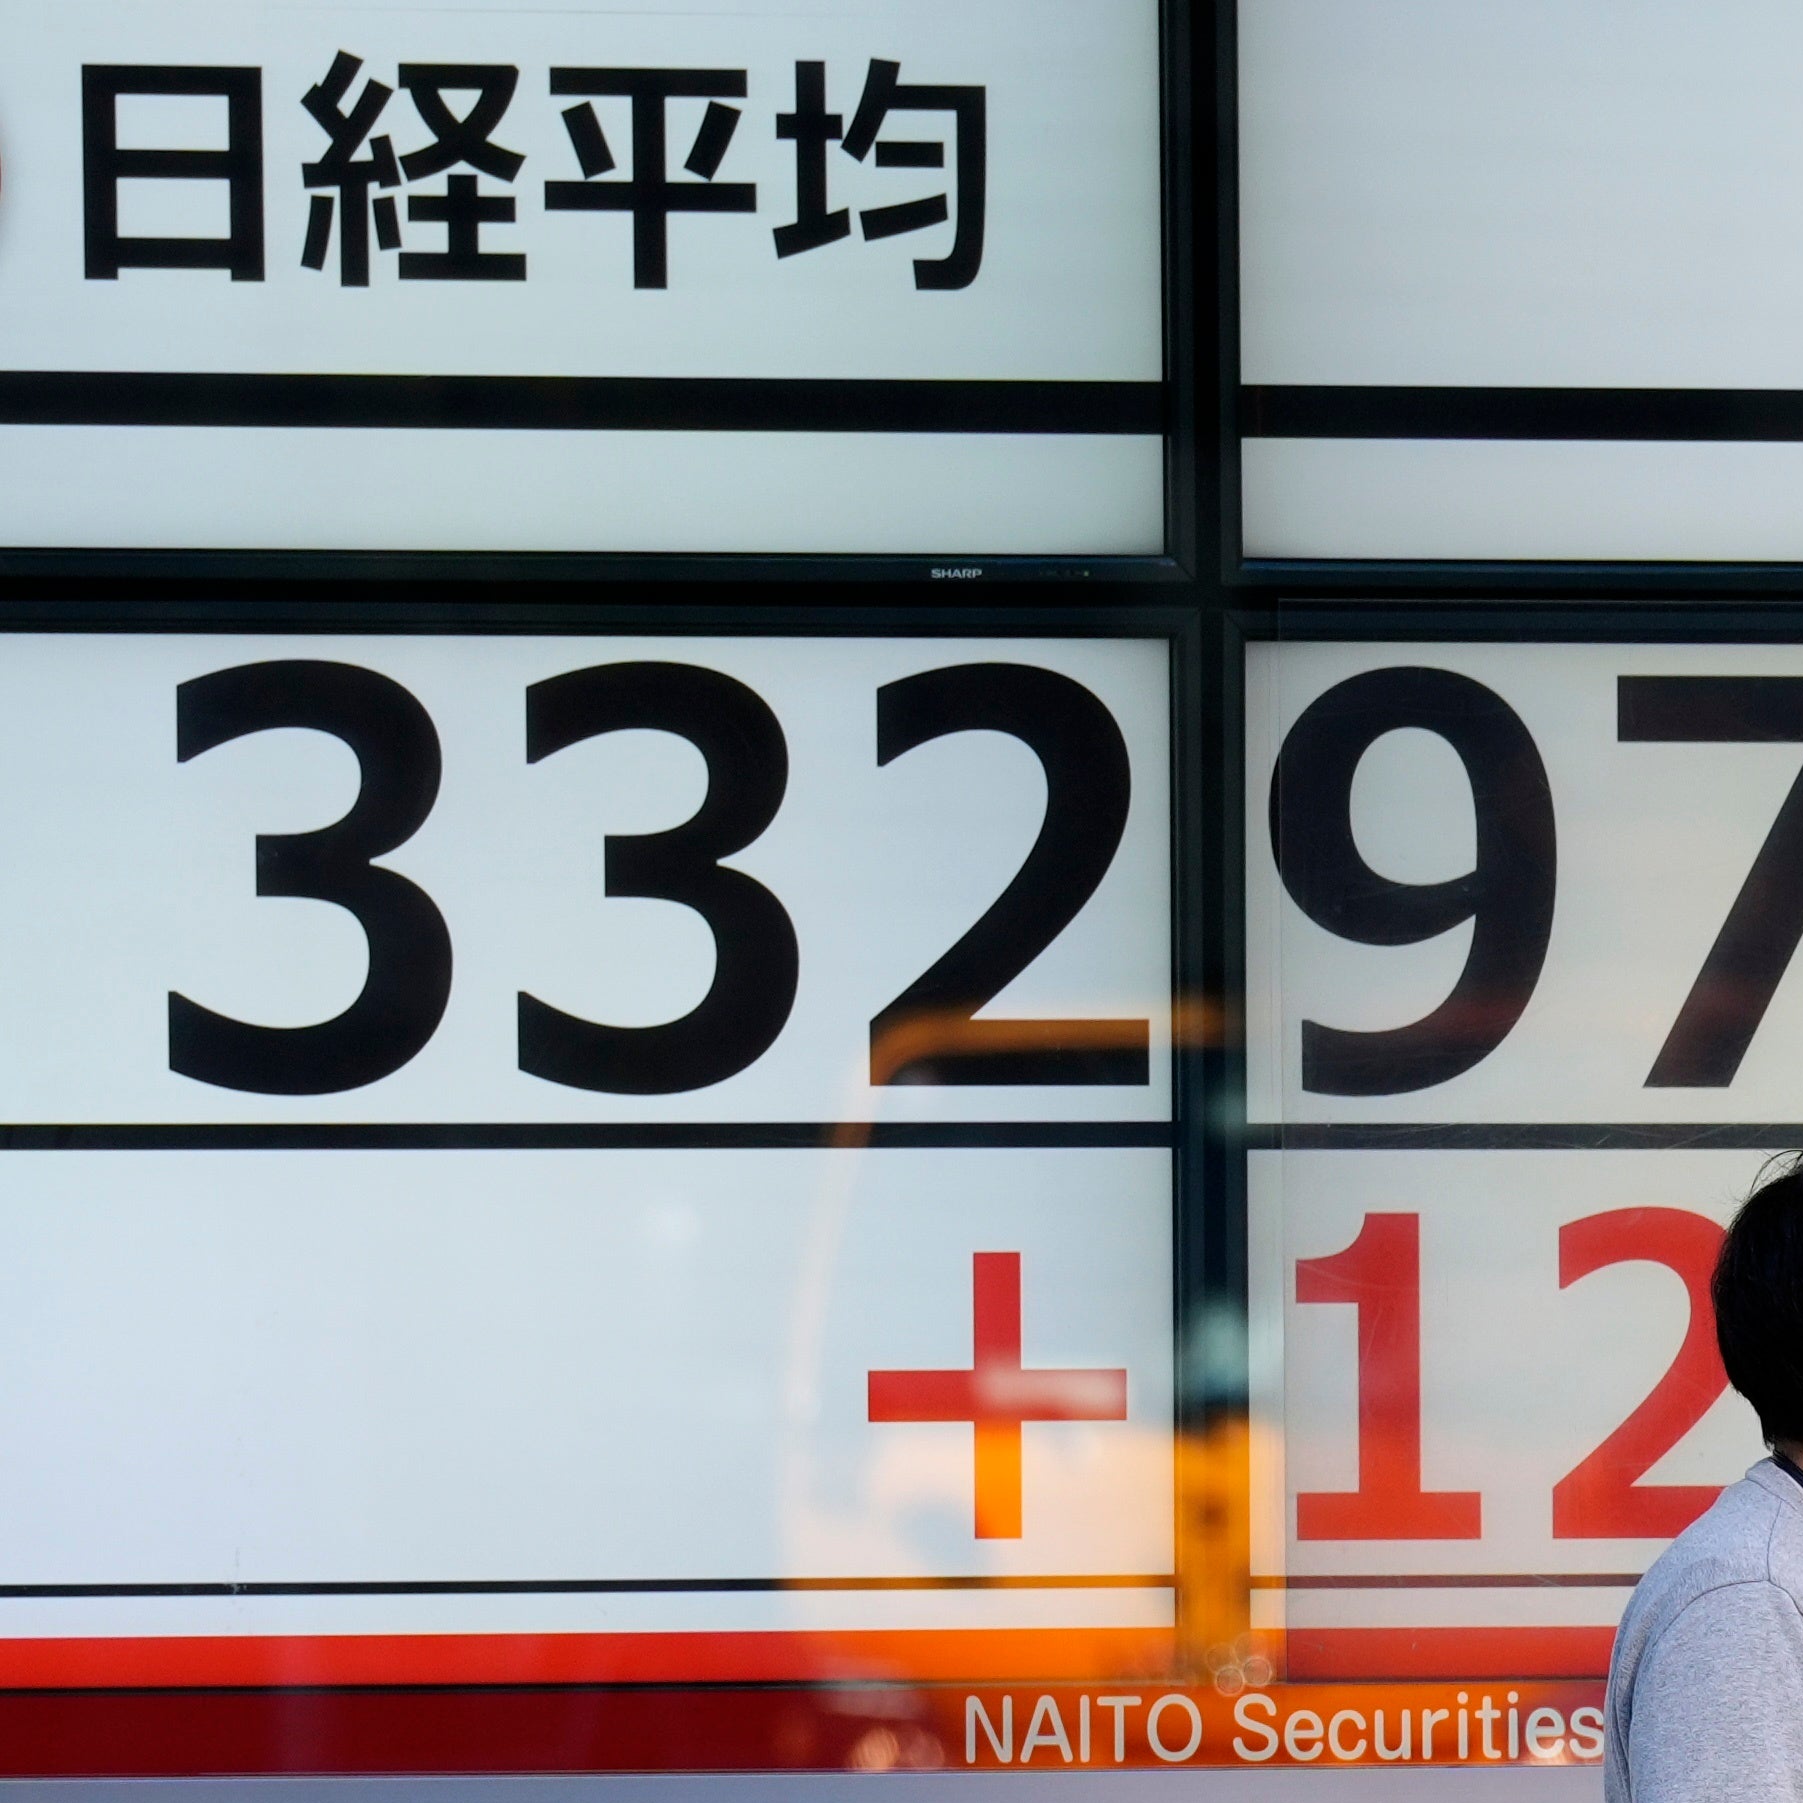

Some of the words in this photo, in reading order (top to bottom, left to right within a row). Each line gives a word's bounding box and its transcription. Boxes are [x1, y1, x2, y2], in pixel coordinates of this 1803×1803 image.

[82, 50, 986, 291] 日経平均
[931, 568, 983, 579] SHARP
[964, 1694, 1202, 1764] NAITO
[1231, 1691, 1605, 1762] Securities
